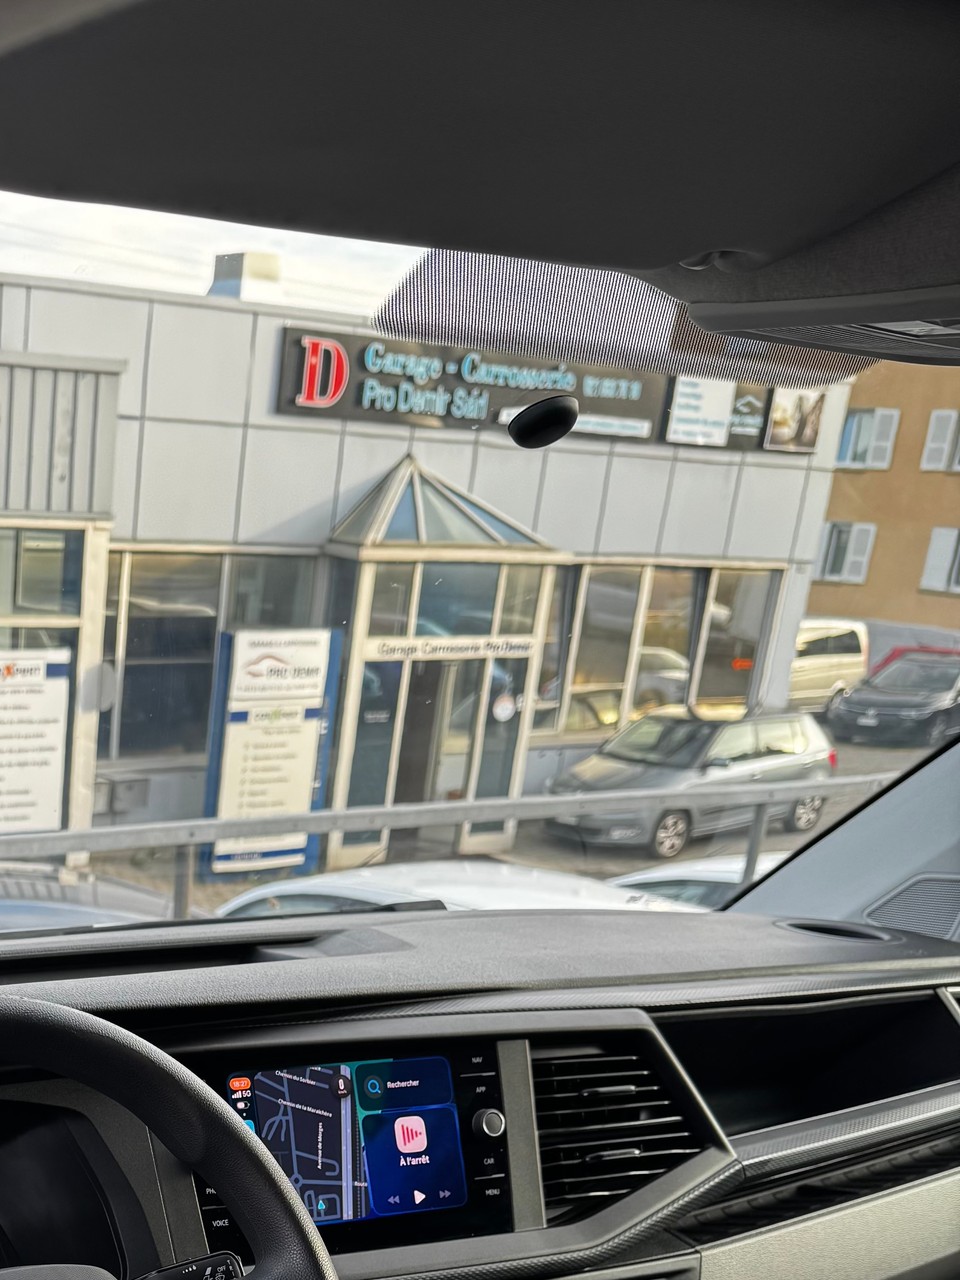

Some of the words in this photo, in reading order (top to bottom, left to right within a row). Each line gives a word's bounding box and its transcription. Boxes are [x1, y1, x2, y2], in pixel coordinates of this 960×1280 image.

[295, 335, 350, 408] D
[364, 341, 443, 385] Garage
[461, 351, 577, 392] Carrosserie
[362, 378, 397, 412] Pro
[387, 1080, 420, 1089] Rechercher
[242, 1090, 252, 1098] 5G
[277, 1098, 296, 1108] Chemin
[399, 1156, 406, 1167] À
[407, 1154, 430, 1165] l'arrêt
[212, 1219, 229, 1227] VOICE
